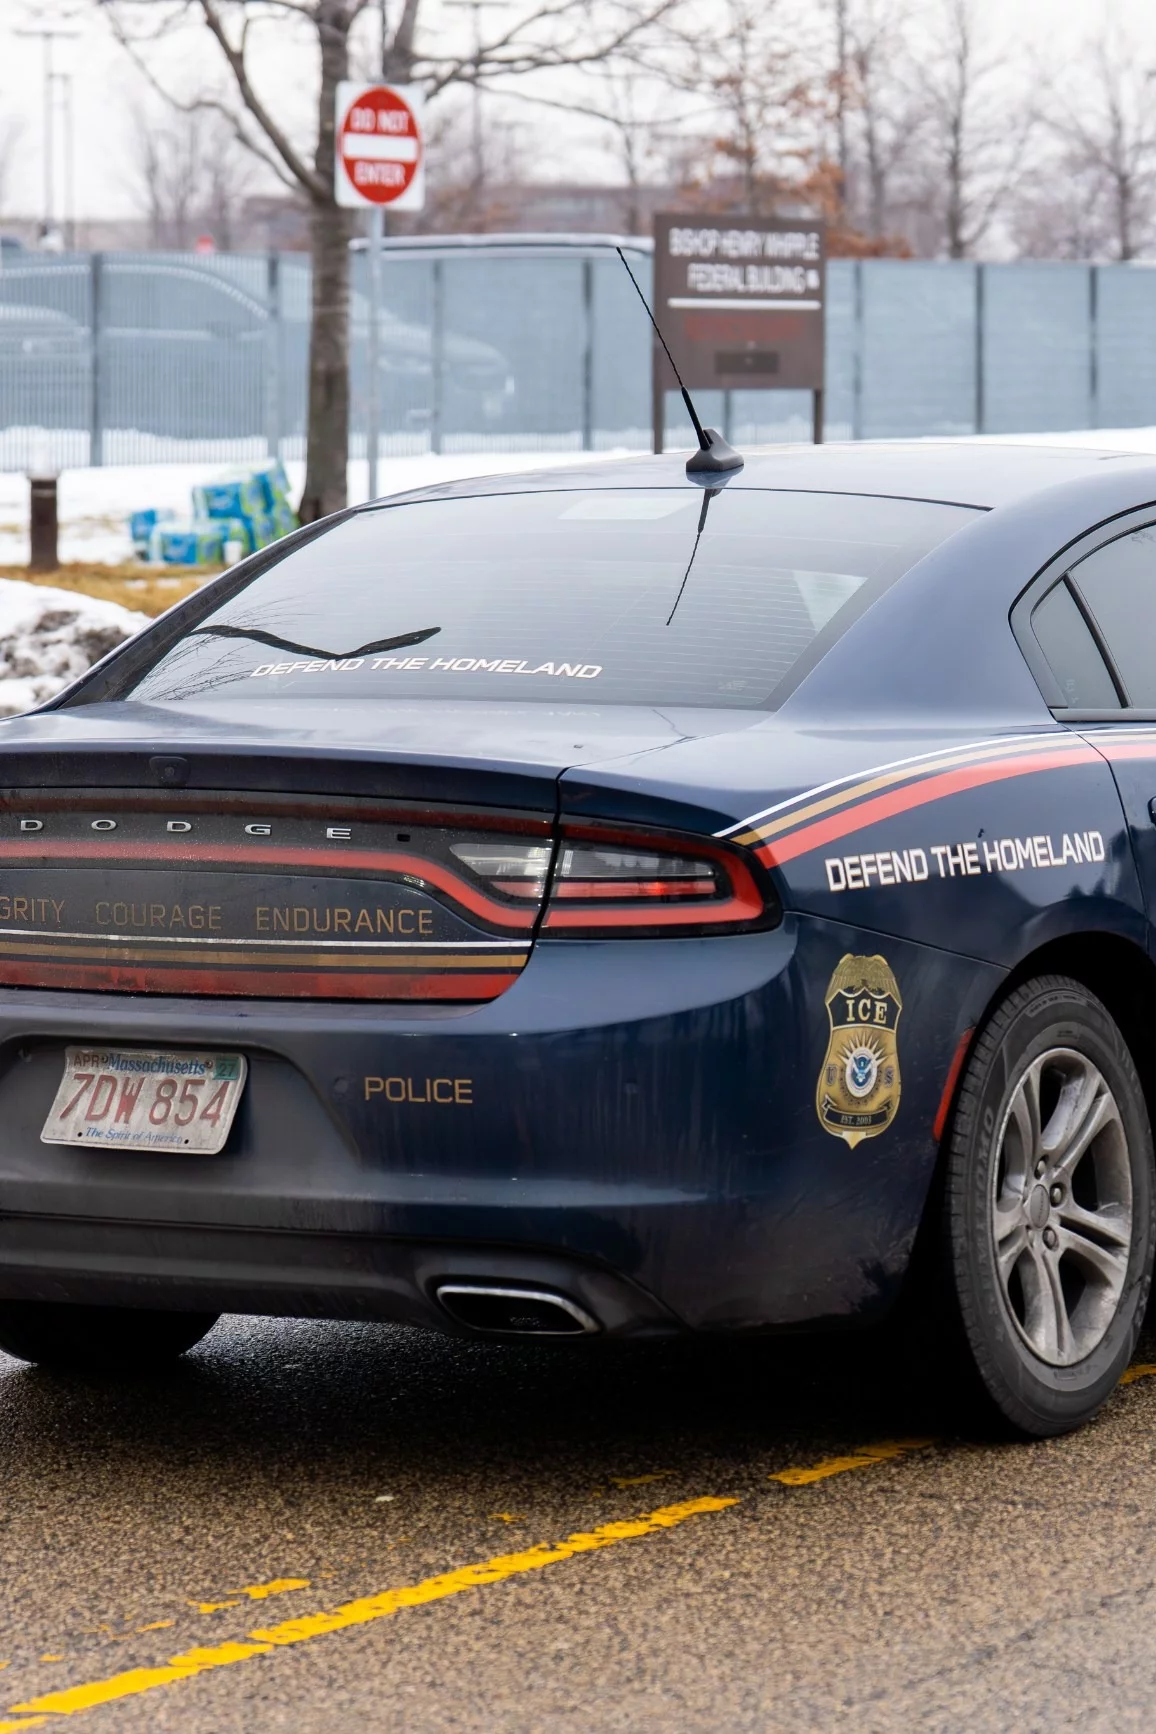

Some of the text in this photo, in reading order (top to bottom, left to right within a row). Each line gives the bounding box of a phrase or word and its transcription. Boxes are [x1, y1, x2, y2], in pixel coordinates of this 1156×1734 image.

[351, 107, 409, 133] DO NOT
[354, 160, 406, 187] ENTER
[250, 656, 604, 679] DEFEND THE HOMELAND
[825, 830, 1106, 892] DEFEND THE HOMELAND
[95, 901, 222, 930] COURAGE
[256, 907, 433, 934] ENDURANCE
[846, 998, 888, 1024] ICE
[74, 1053, 206, 1076] APR Massachusetts
[218, 1063, 235, 1077] 27
[60, 1073, 231, 1128] 7DW 854
[364, 1077, 473, 1103] POLICE
[86, 1127, 103, 1138] The
[105, 1128, 131, 1141] Spirit
